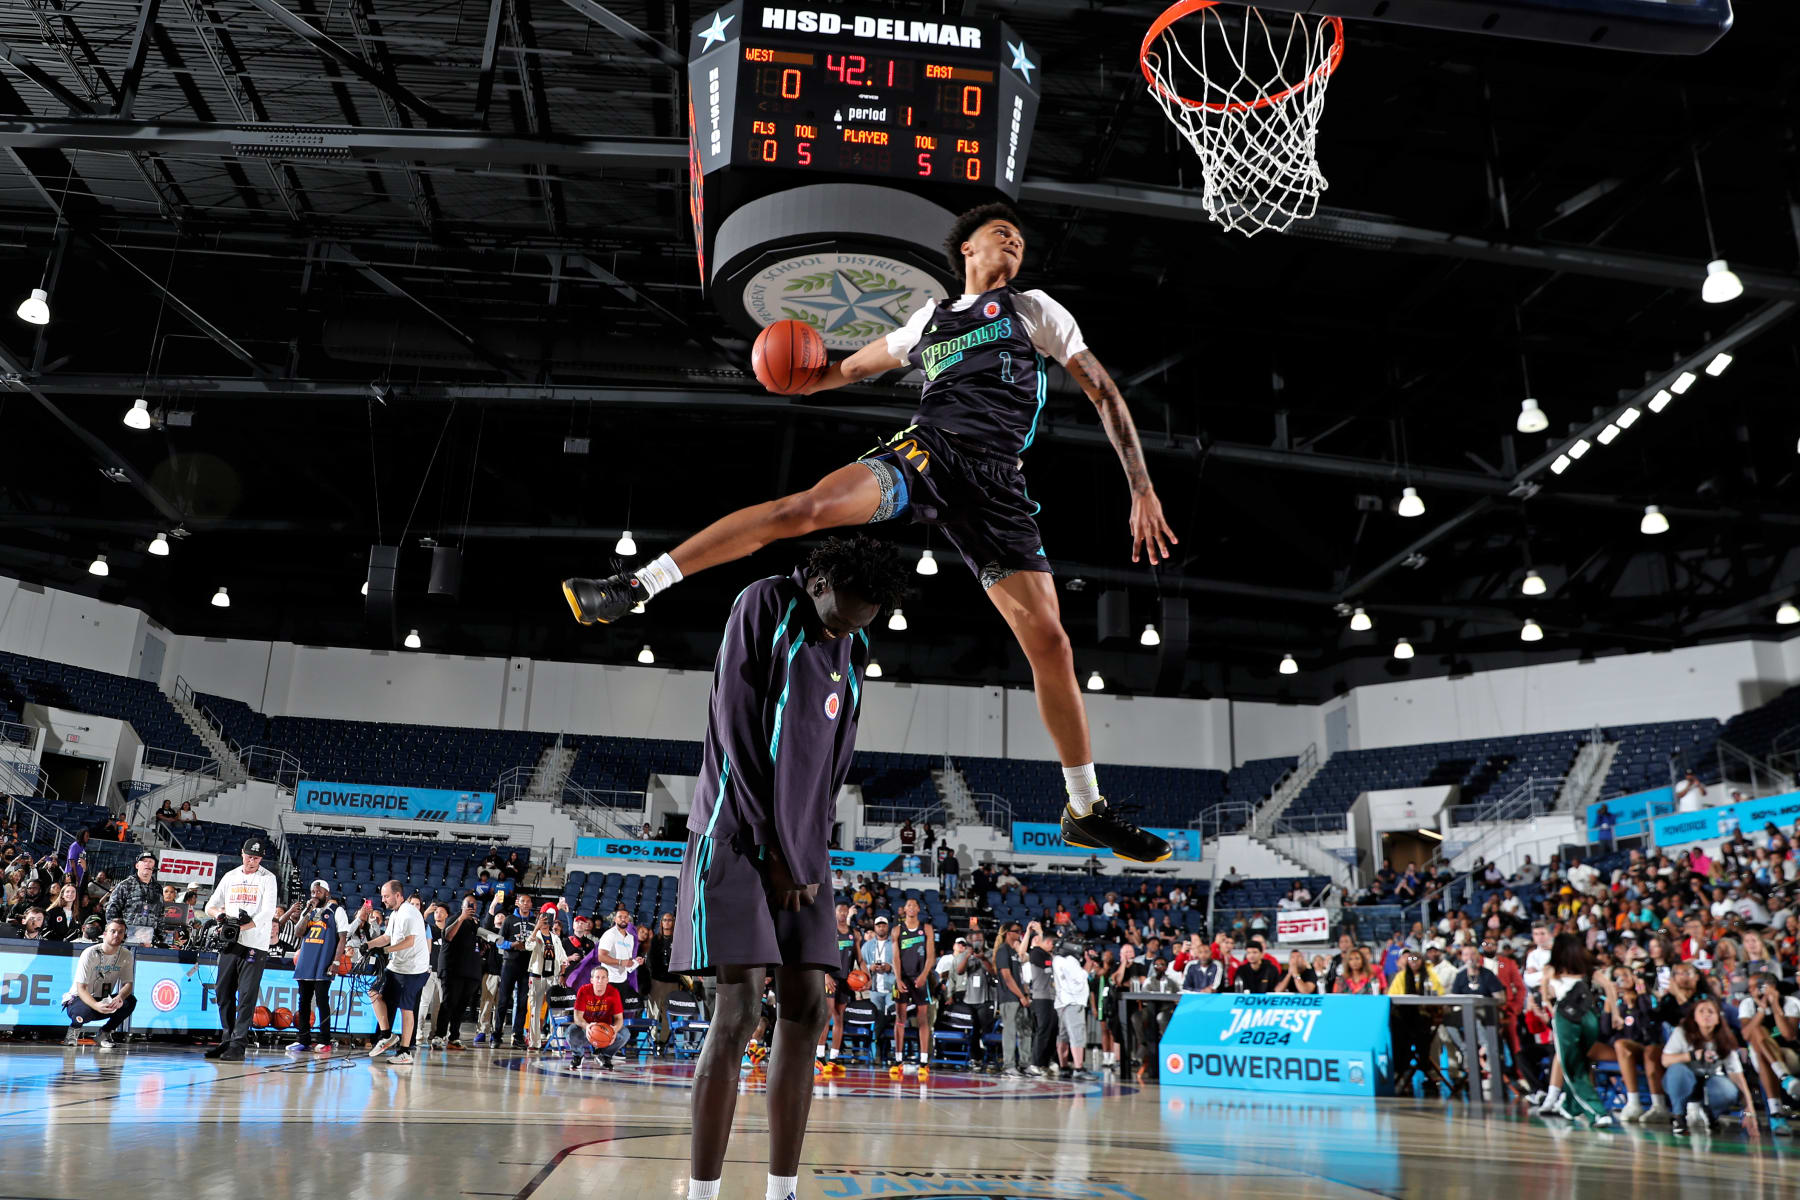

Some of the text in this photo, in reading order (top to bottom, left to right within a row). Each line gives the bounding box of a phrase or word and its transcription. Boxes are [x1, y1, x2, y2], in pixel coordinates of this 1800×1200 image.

[762, 7, 982, 49] HISD-DELMAR
[745, 47, 775, 63] WEST
[926, 64, 954, 79] EAST
[781, 69, 802, 99] 0
[962, 85, 982, 116] 0
[709, 67, 721, 156] HOUSTON
[848, 107, 887, 122] period
[752, 121, 776, 135] FLS
[795, 124, 816, 139] TOL
[843, 129, 889, 146] PLAYER
[915, 135, 936, 150] TOL
[956, 139, 980, 154] FLS
[1004, 94, 1024, 182] HOUSTON
[762, 139, 778, 163] 0
[797, 142, 812, 166] 5
[917, 153, 932, 176] 5
[966, 157, 981, 181] 0
[751, 255, 912, 324] PENDENT SCHOOL DISTRICT
[999, 351, 1015, 384] 1
[306, 789, 409, 810] POWERADE
[1023, 831, 1073, 848] POW
[605, 843, 684, 858] 50% MO
[159, 858, 214, 877] ESPN
[829, 856, 855, 867] ES
[309, 926, 322, 939] 77
[1277, 917, 1327, 935] ESPN
[1234, 996, 1324, 1007] POWERADE
[1220, 1008, 1322, 1043] JAMFEST
[1239, 1031, 1292, 1046] 2024
[1188, 1053, 1341, 1083] POWERADE
